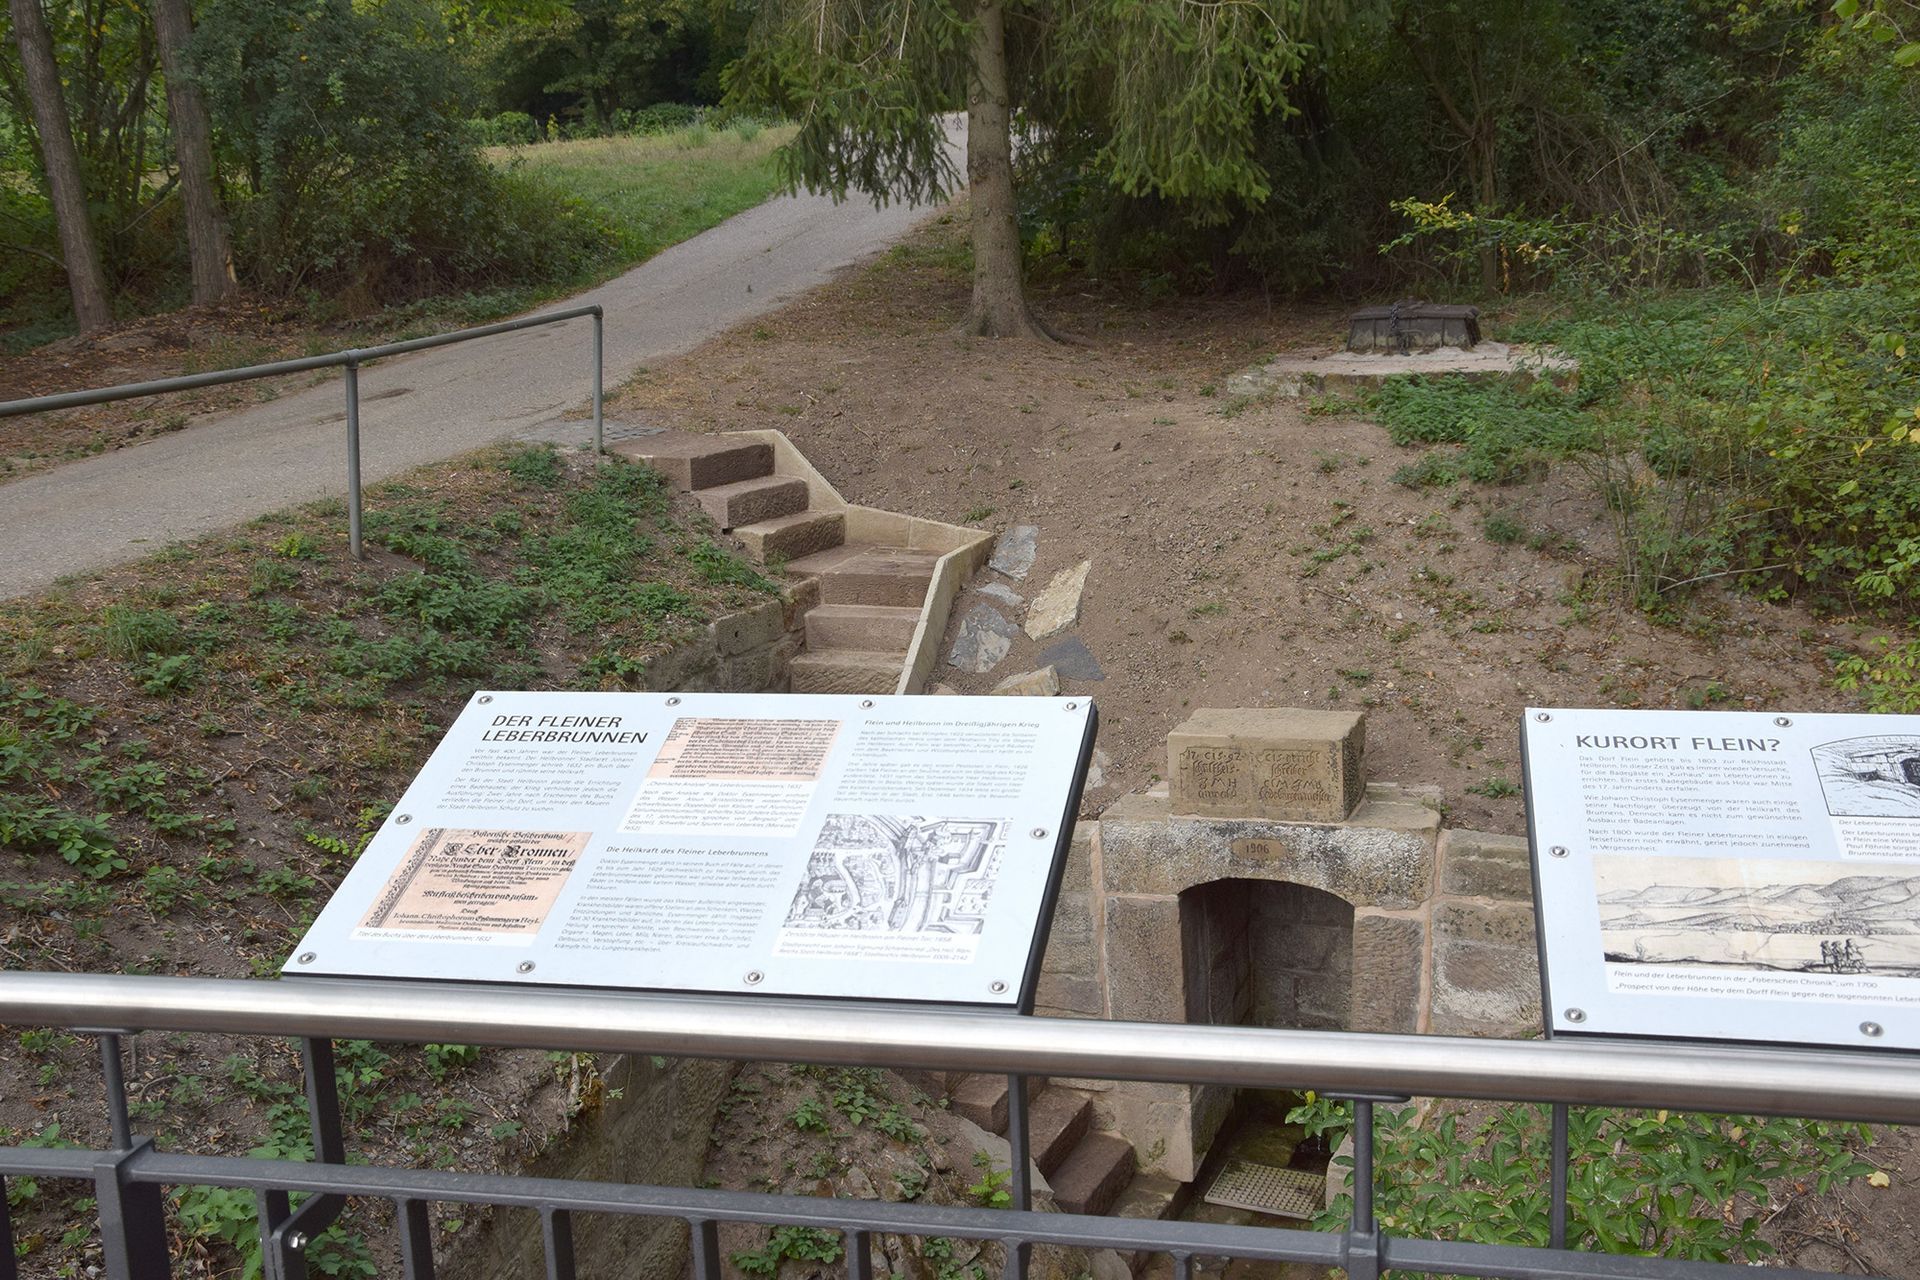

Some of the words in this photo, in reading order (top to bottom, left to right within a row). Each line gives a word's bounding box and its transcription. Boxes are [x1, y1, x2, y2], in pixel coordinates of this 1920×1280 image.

[492, 715, 532, 726] DER
[538, 716, 622, 728] FLEINER
[482, 730, 648, 743] LEBERBRUNNEN
[1576, 736, 1680, 749] KURORT
[1691, 737, 1780, 752] FLEIN?
[1746, 813, 1802, 821] gewünschten
[1246, 843, 1269, 853] 1906
